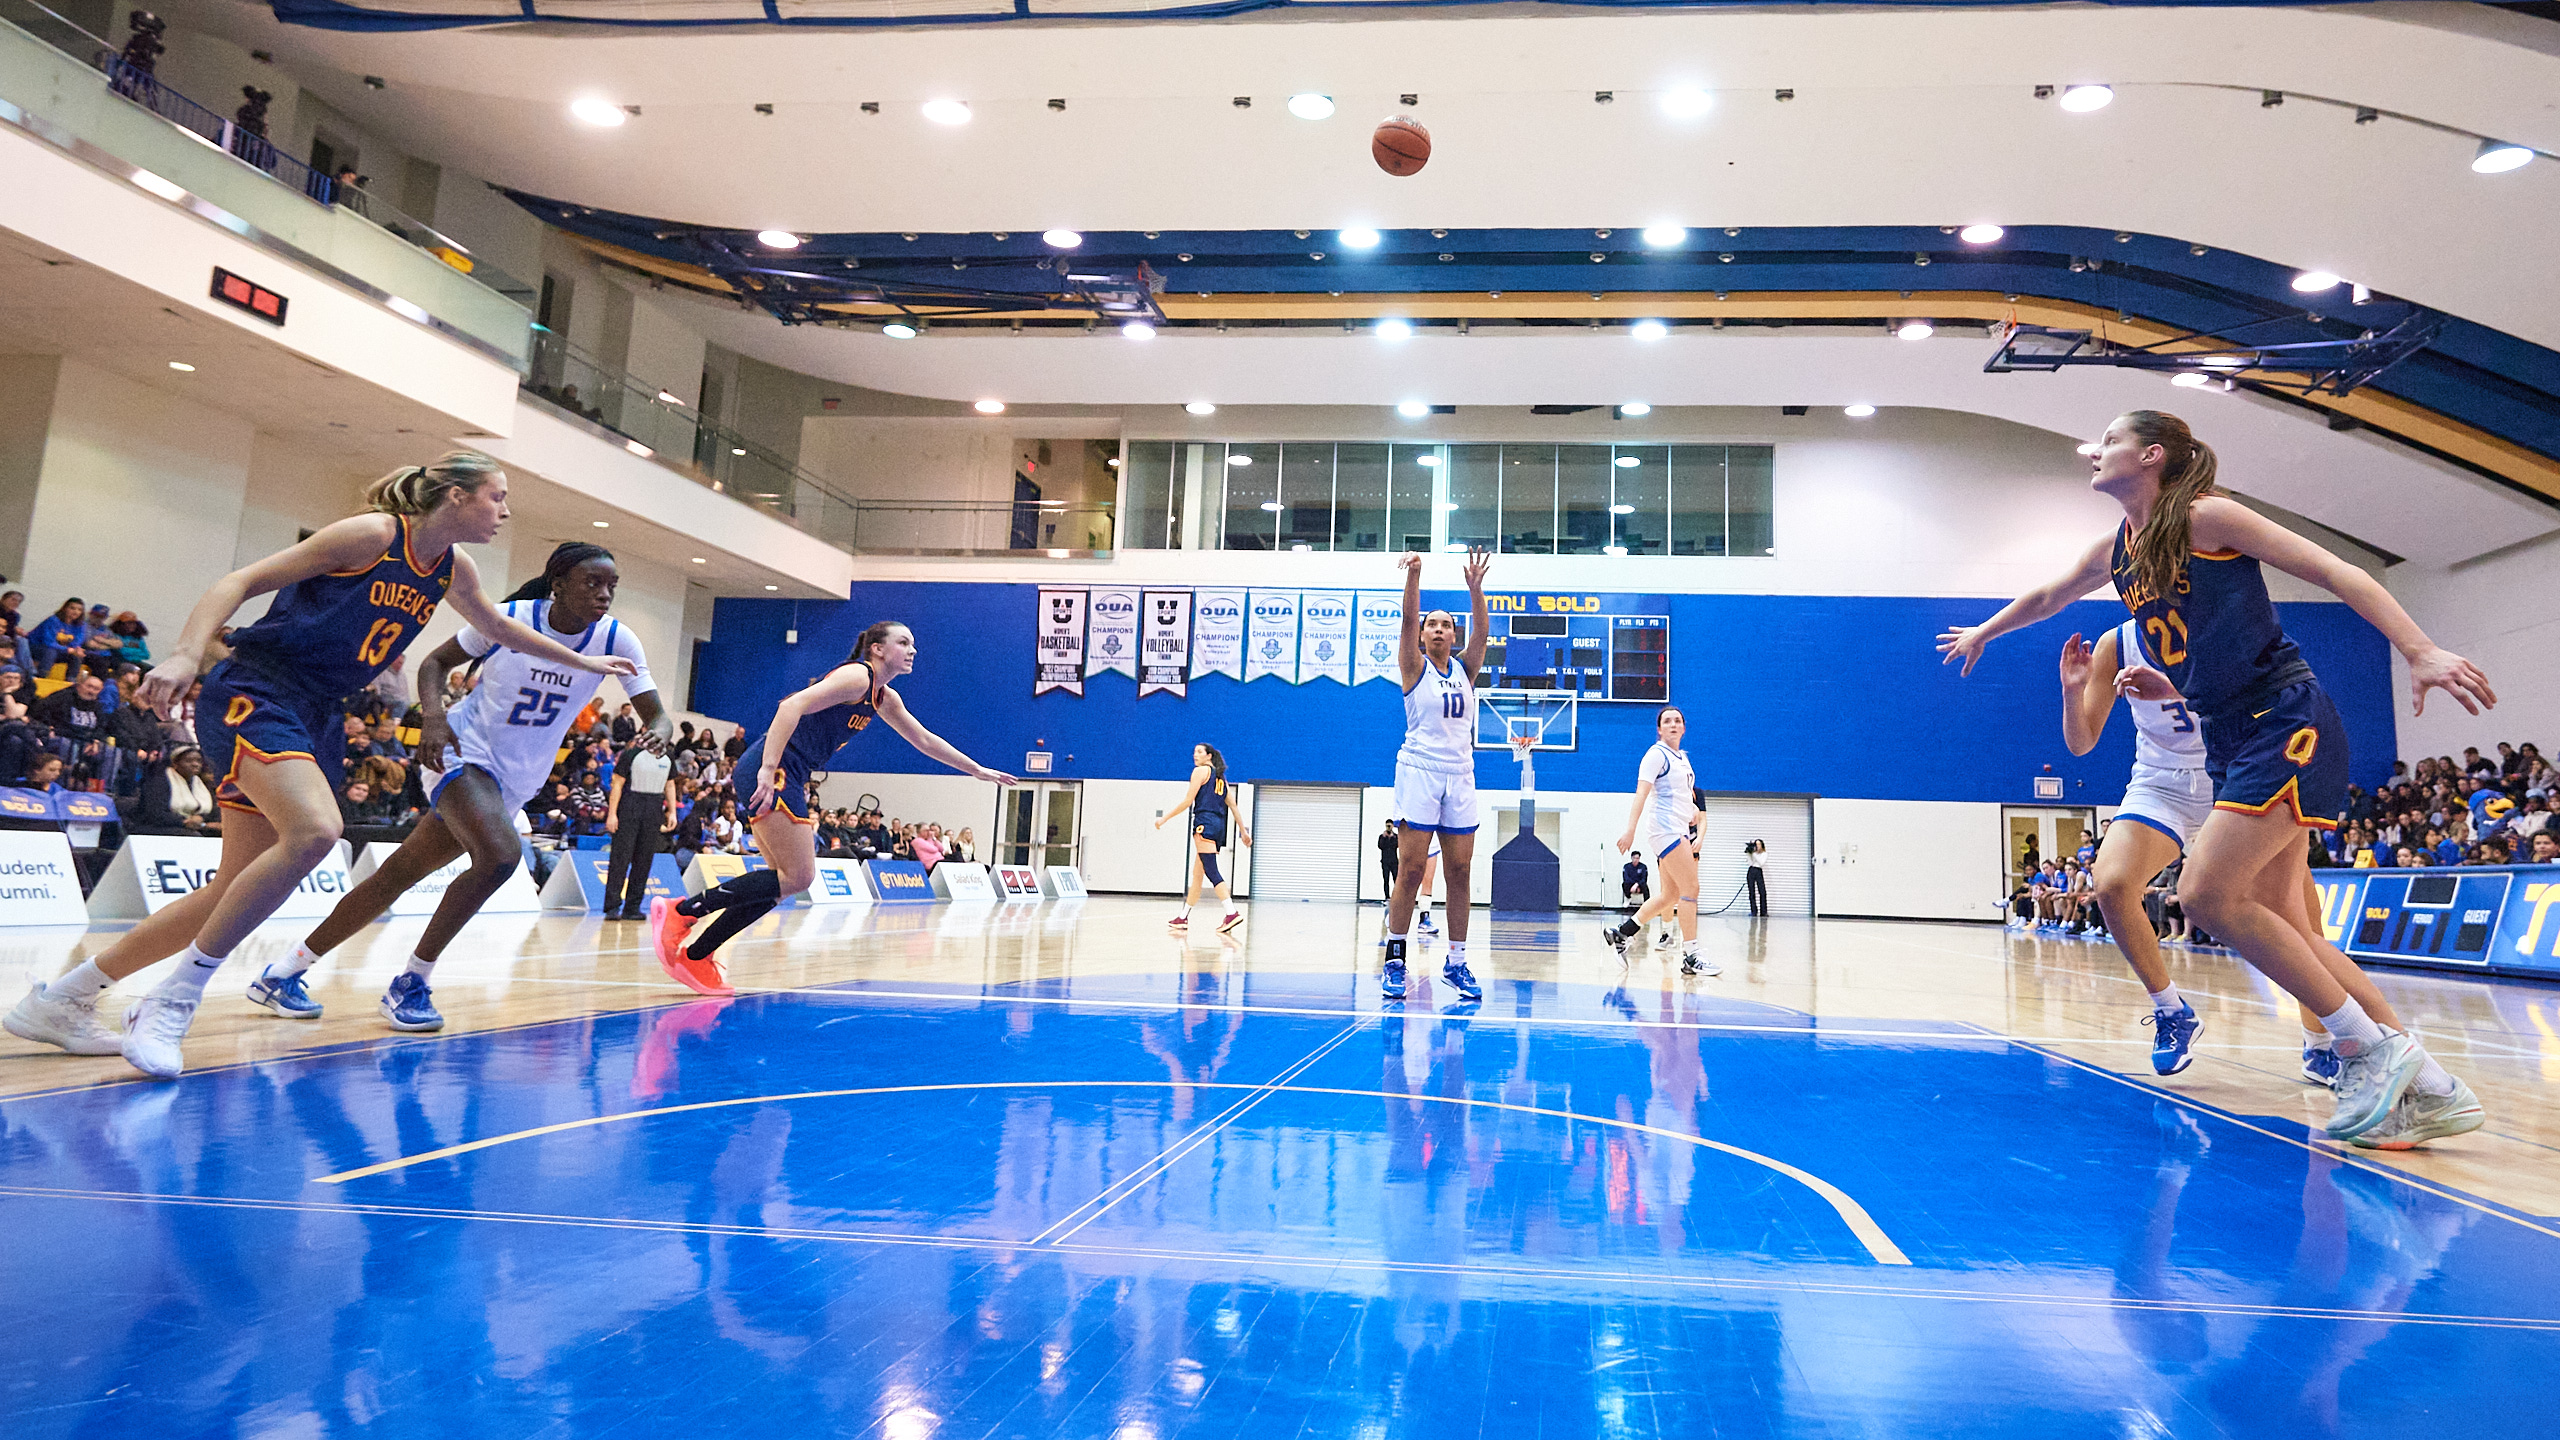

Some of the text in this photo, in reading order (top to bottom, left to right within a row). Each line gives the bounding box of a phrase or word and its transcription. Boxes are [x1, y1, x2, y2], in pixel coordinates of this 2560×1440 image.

[368, 580, 437, 627] QUEEN'S
[1095, 603, 1134, 612] OUA
[1254, 606, 1293, 615] OUA
[1483, 595, 1600, 612] TMU BOLD
[1200, 607, 1239, 616] OUA
[1307, 608, 1346, 617] OUA
[1362, 609, 1402, 618] OUA
[1092, 626, 1134, 634] CHAMPIONS
[1196, 633, 1240, 641] CHAMPIONS
[1252, 630, 1294, 638] CHAMPIONS
[1304, 632, 1347, 640] CHAMPIONS
[356, 616, 403, 667] 13
[1041, 635, 1080, 650] BASKETBALL
[1146, 638, 1184, 652] VOLLEYBALL
[1573, 638, 1601, 648] GUEST
[2146, 608, 2188, 668] 21
[530, 667, 573, 688] TMU
[506, 686, 569, 727] 25
[1442, 692, 1465, 718] 10
[2161, 700, 2195, 733] 3
[2283, 726, 2320, 768] Q
[1214, 777, 1225, 796] 10
[2, 800, 46, 814] BOLD
[67, 804, 109, 816] BOLD
[0, 860, 65, 878] udent,
[145, 867, 163, 894] the
[879, 871, 926, 889] @TMUbold
[0, 883, 57, 899] umni.
[2365, 907, 2390, 919] BOLD
[2412, 913, 2435, 924] PERIOD
[2462, 909, 2492, 924] GUEST
